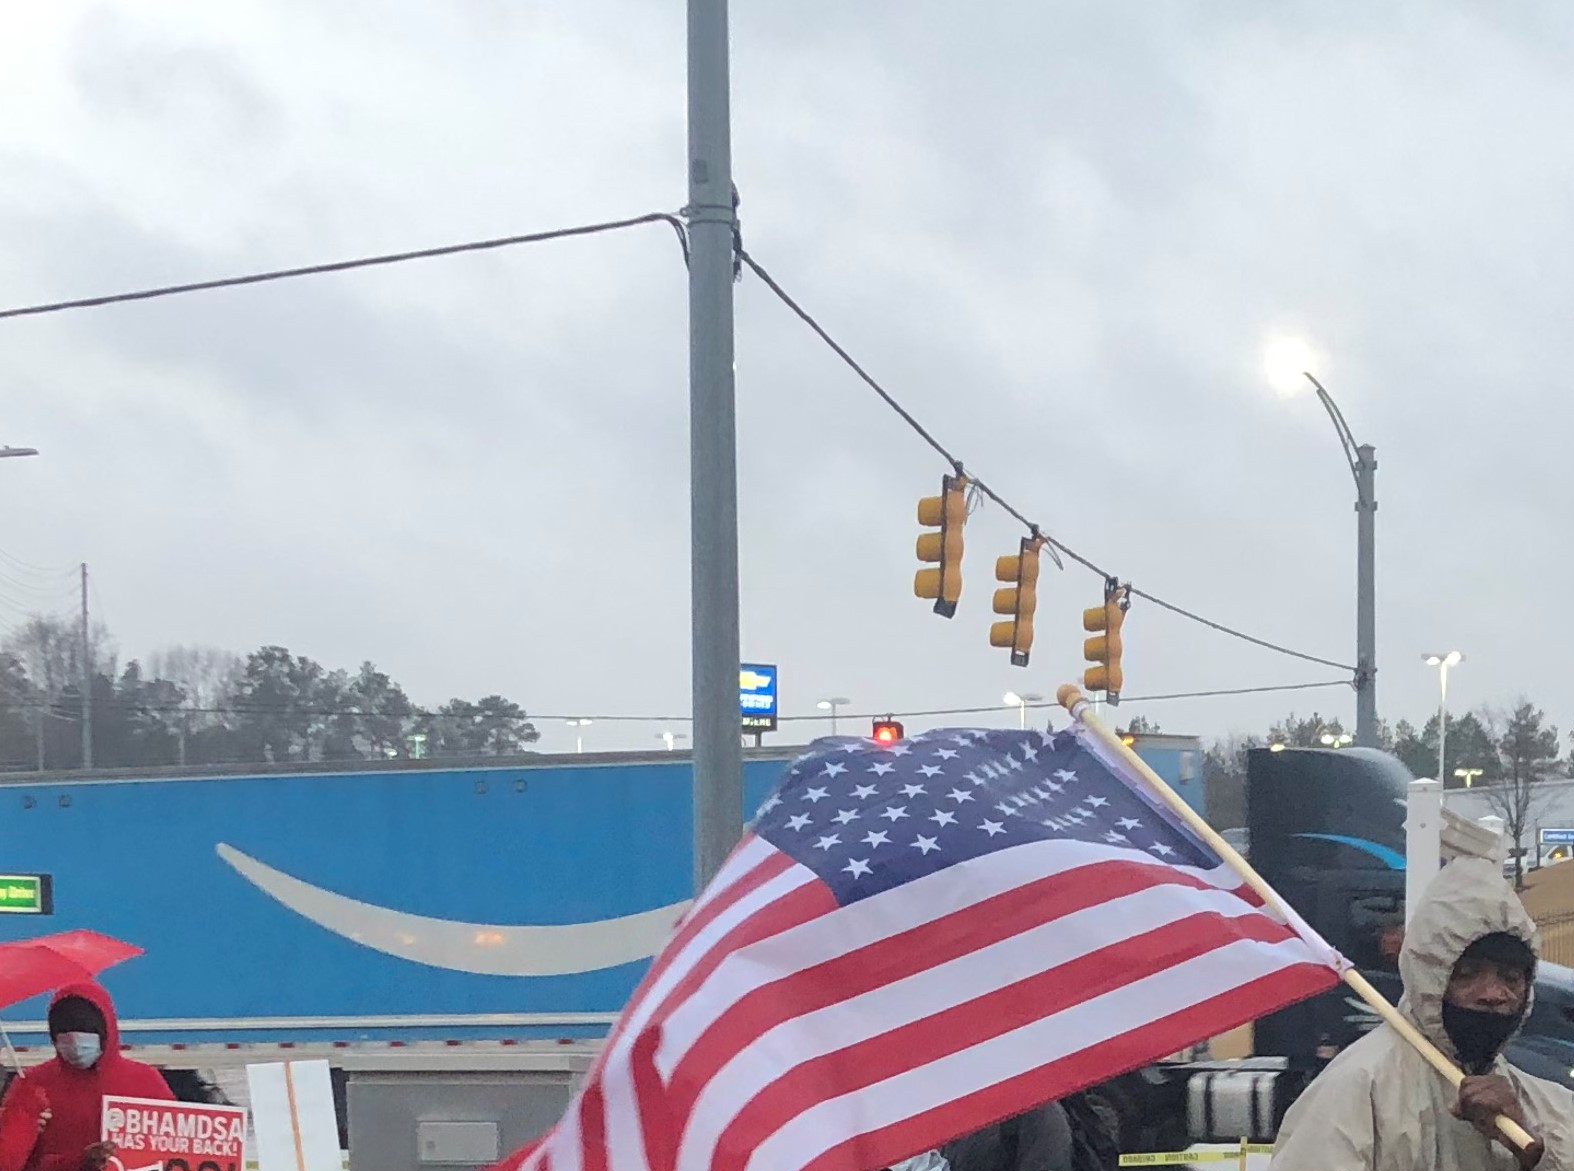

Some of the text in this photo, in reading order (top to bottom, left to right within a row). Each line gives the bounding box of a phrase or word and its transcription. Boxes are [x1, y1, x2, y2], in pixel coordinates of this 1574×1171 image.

[107, 1108, 243, 1141] @BHAMDSA
[111, 1132, 237, 1156] HAS YOUR BACK!
